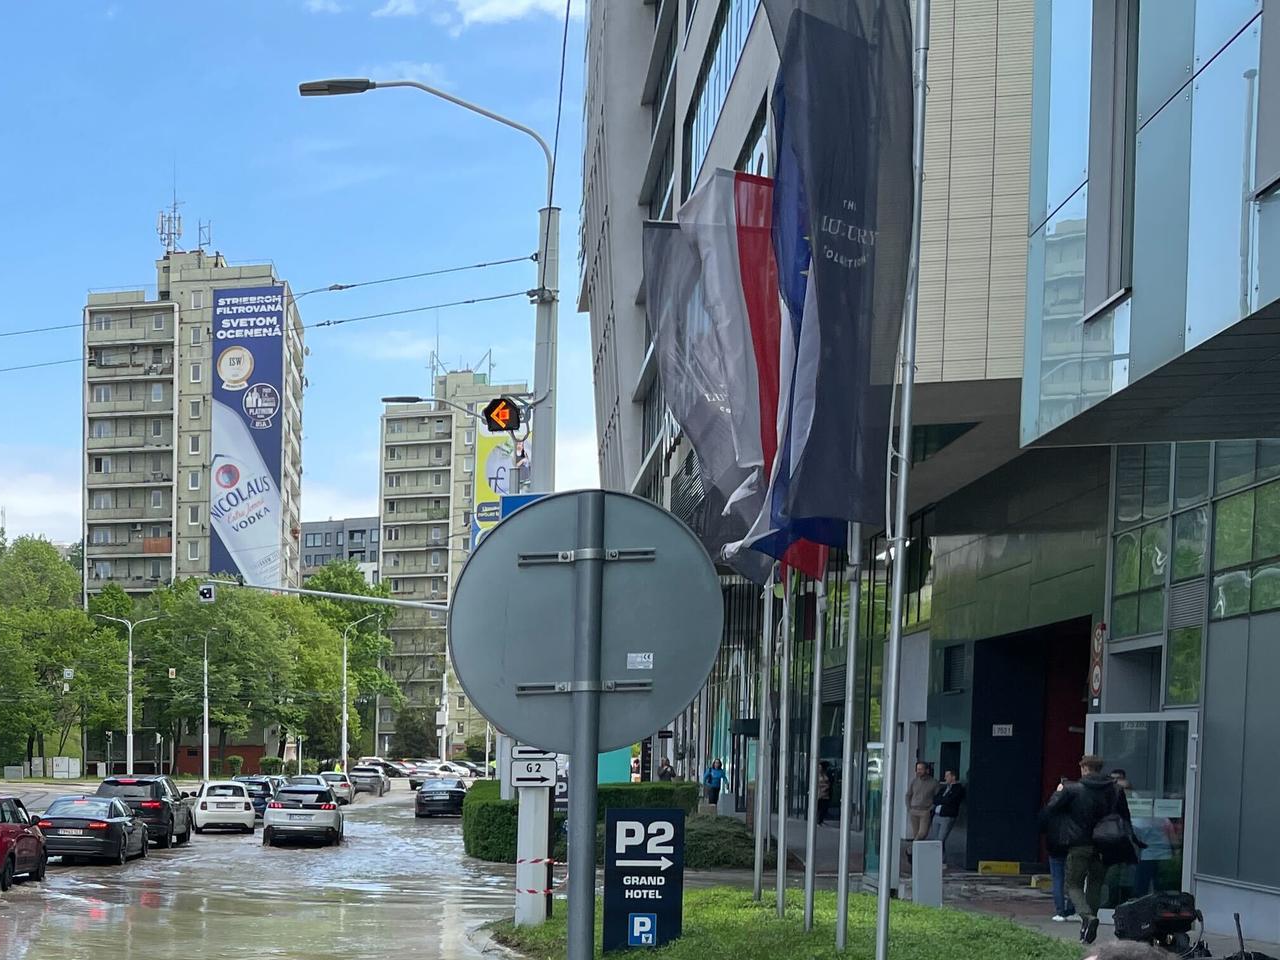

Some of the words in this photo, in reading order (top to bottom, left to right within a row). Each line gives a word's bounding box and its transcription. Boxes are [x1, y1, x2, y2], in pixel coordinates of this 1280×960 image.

[822, 215, 879, 245] LUURY
[216, 303, 283, 315] FILTROVANÁ
[221, 317, 277, 328] SVETOM
[216, 325, 282, 339] OCENENÁ
[210, 475, 271, 520] NICOLAUS
[232, 506, 271, 532] VODKA
[615, 821, 675, 854] P2
[623, 876, 666, 886] GRAND
[625, 889, 663, 899] HOTEL
[633, 917, 652, 936] P
